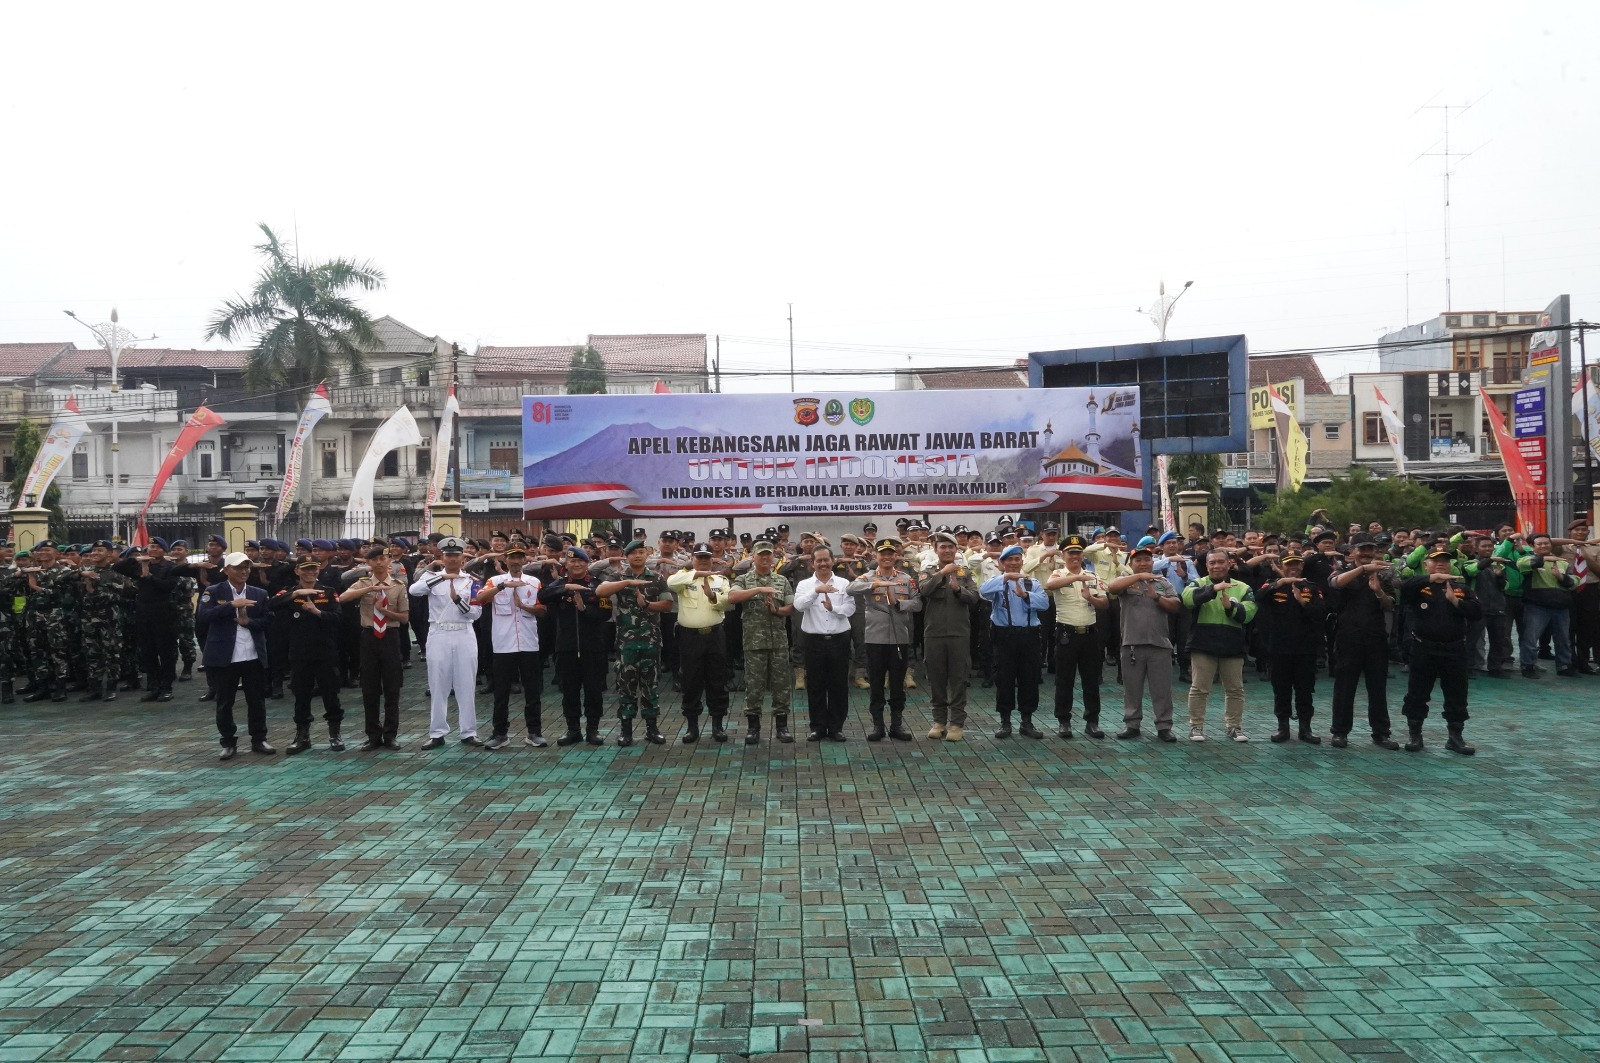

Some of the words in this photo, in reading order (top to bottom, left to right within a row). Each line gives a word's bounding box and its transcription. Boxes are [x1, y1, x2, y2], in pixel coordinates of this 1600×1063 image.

[1252, 385, 1295, 410] POSI
[532, 401, 552, 425] 81
[628, 437, 671, 454] APEL
[676, 435, 800, 454] KEBANGSAAN
[805, 434, 850, 452] JAGA
[855, 433, 920, 451] RAWAT
[925, 432, 975, 450] JAWA
[980, 431, 1039, 449] BARAT
[688, 457, 798, 481] UNTUK
[805, 454, 980, 480] INDONESIA
[661, 486, 751, 499] INDONESIA
[755, 484, 850, 498] BERDAULAT,
[854, 483, 891, 496] ADIL
[895, 483, 928, 496] DAN
[932, 482, 1008, 495] MAKMUR
[778, 504, 829, 513] Tasikmalaya,
[830, 504, 839, 512] 14
[839, 504, 872, 513] Agustus
[872, 503, 893, 511] 2026
